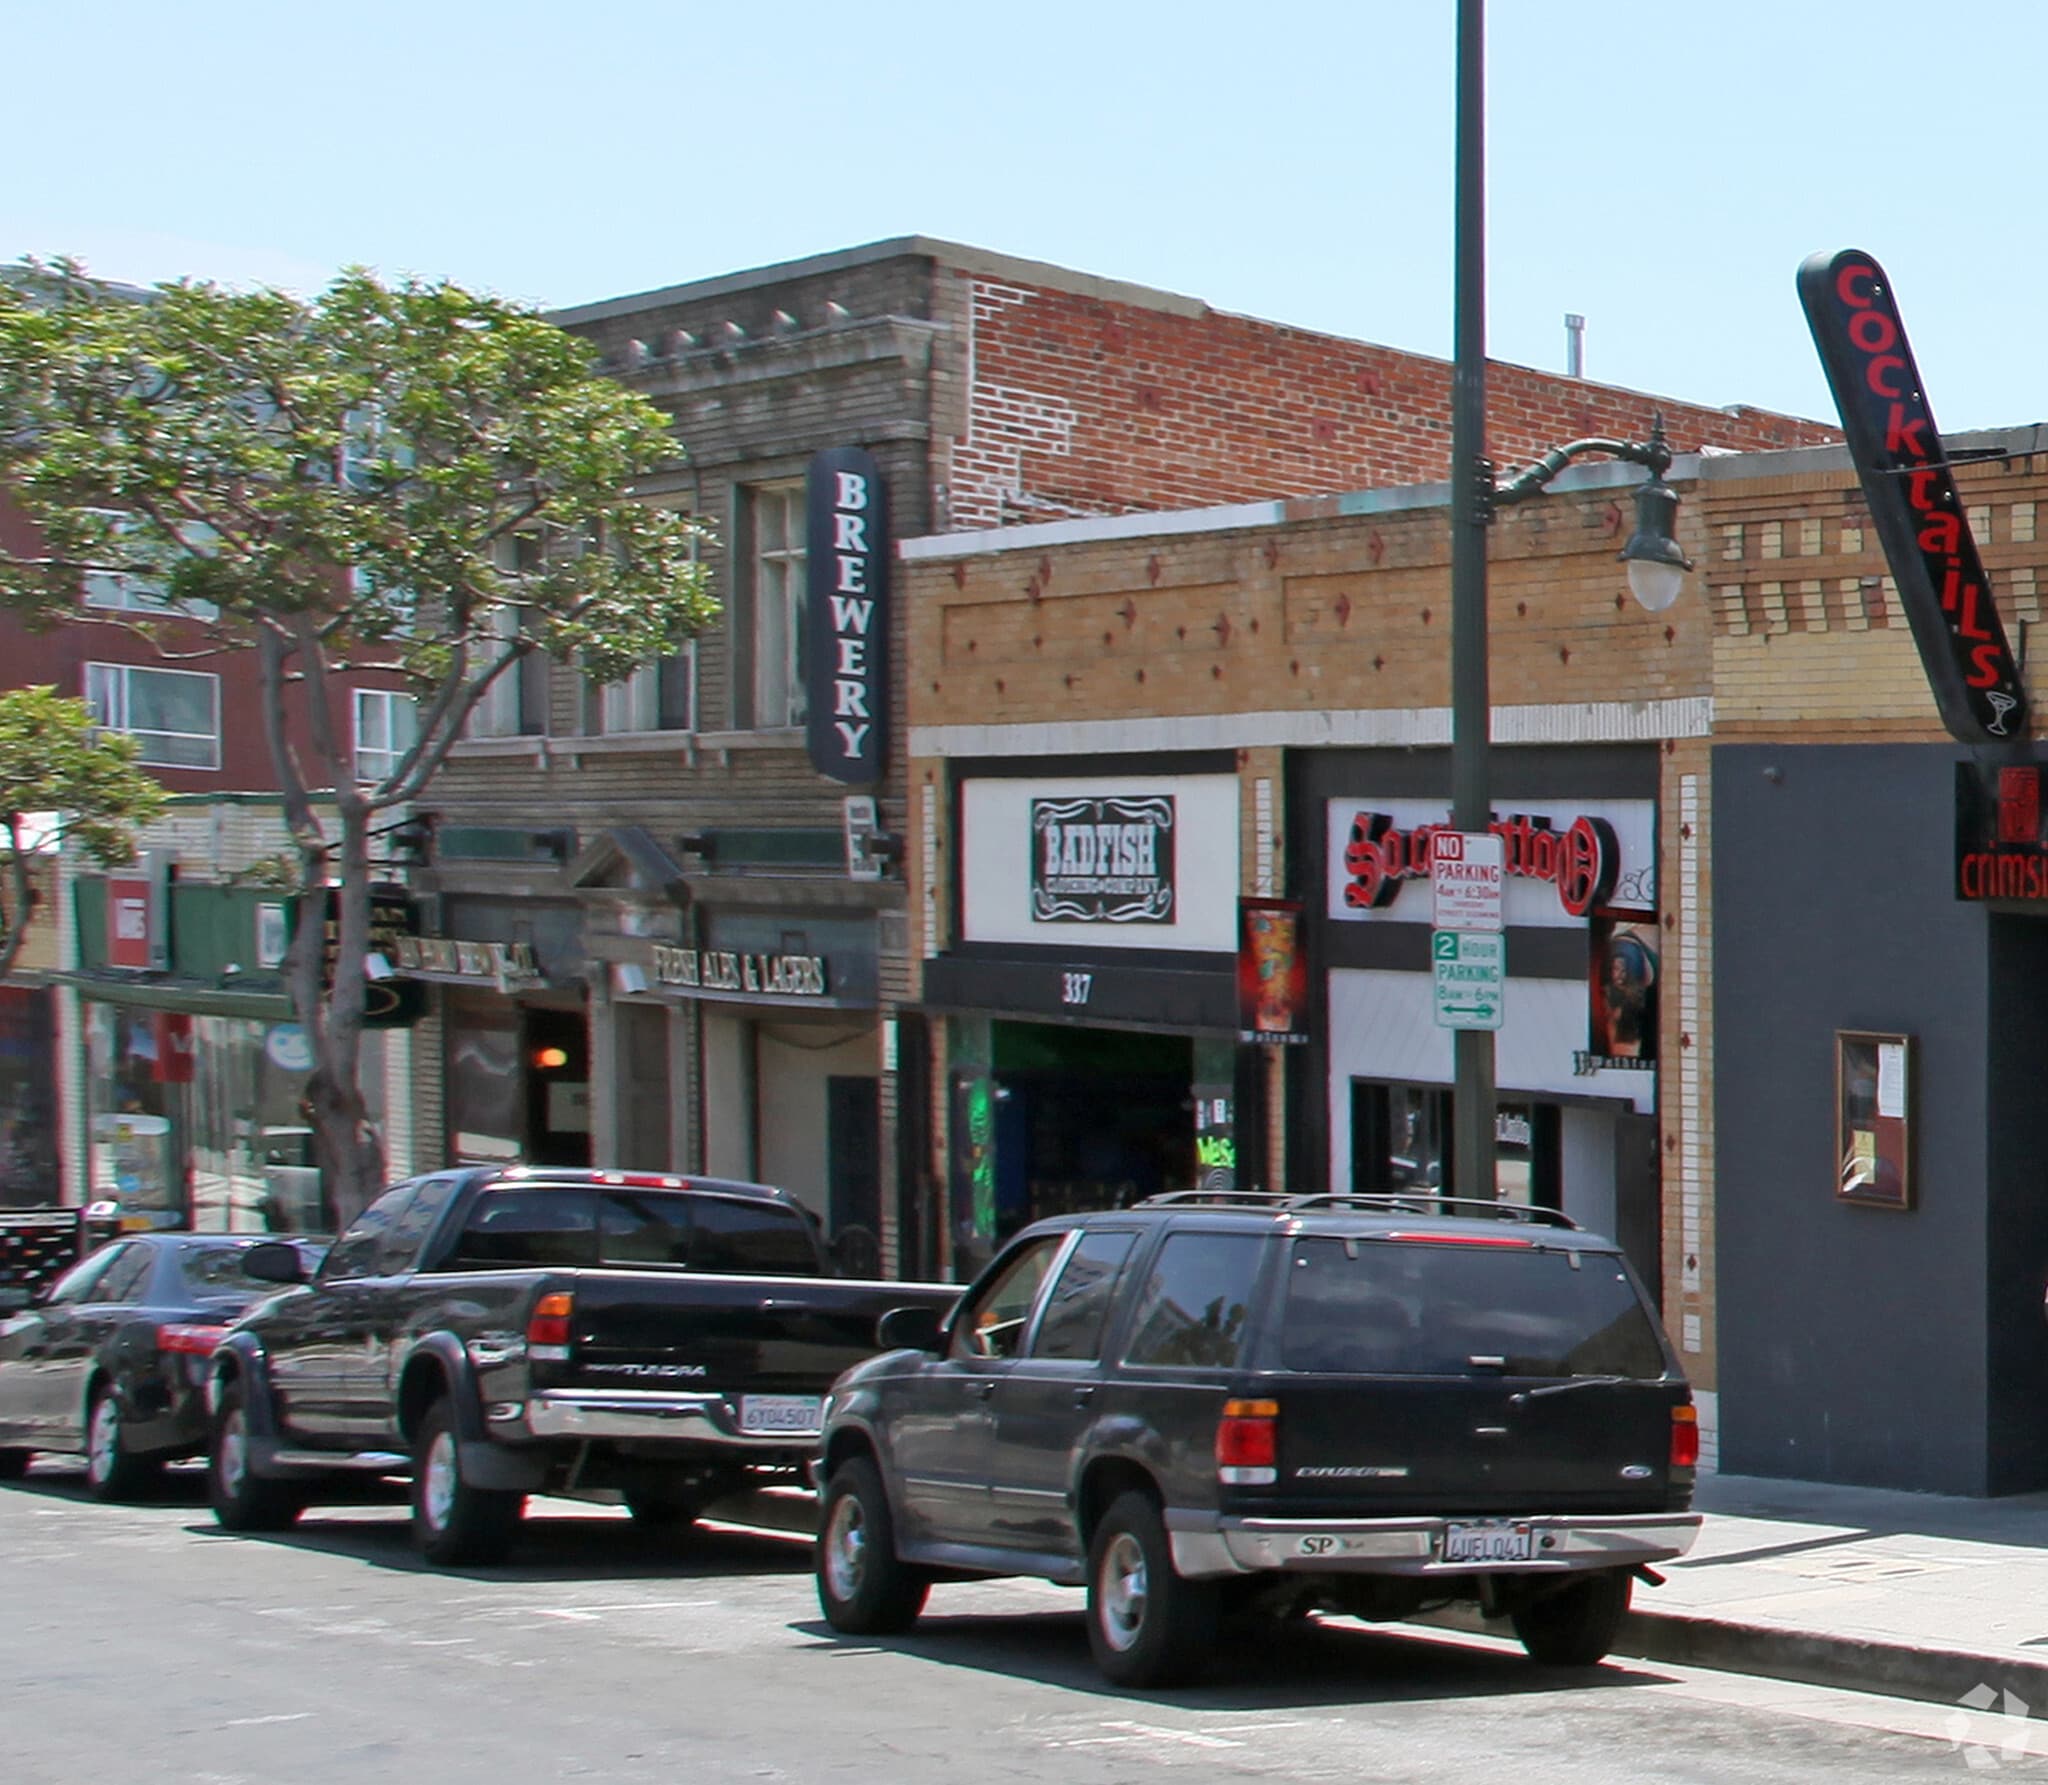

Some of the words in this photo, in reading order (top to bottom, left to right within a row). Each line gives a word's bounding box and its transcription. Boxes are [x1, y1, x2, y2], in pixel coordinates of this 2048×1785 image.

[829, 471, 875, 759] BREWERY
[1045, 823, 1156, 875] BADFISH
[1437, 835, 1460, 857] NO
[1436, 862, 1499, 883] PARKING
[1437, 935, 1455, 957] 2
[1462, 941, 1498, 957] HOUR
[652, 944, 700, 986] FRESH
[702, 950, 741, 990] ALES
[761, 953, 825, 995] LAGERS
[1438, 963, 1498, 983] PARKING
[1062, 972, 1091, 1004] 337
[1301, 1536, 1333, 1554] SP
